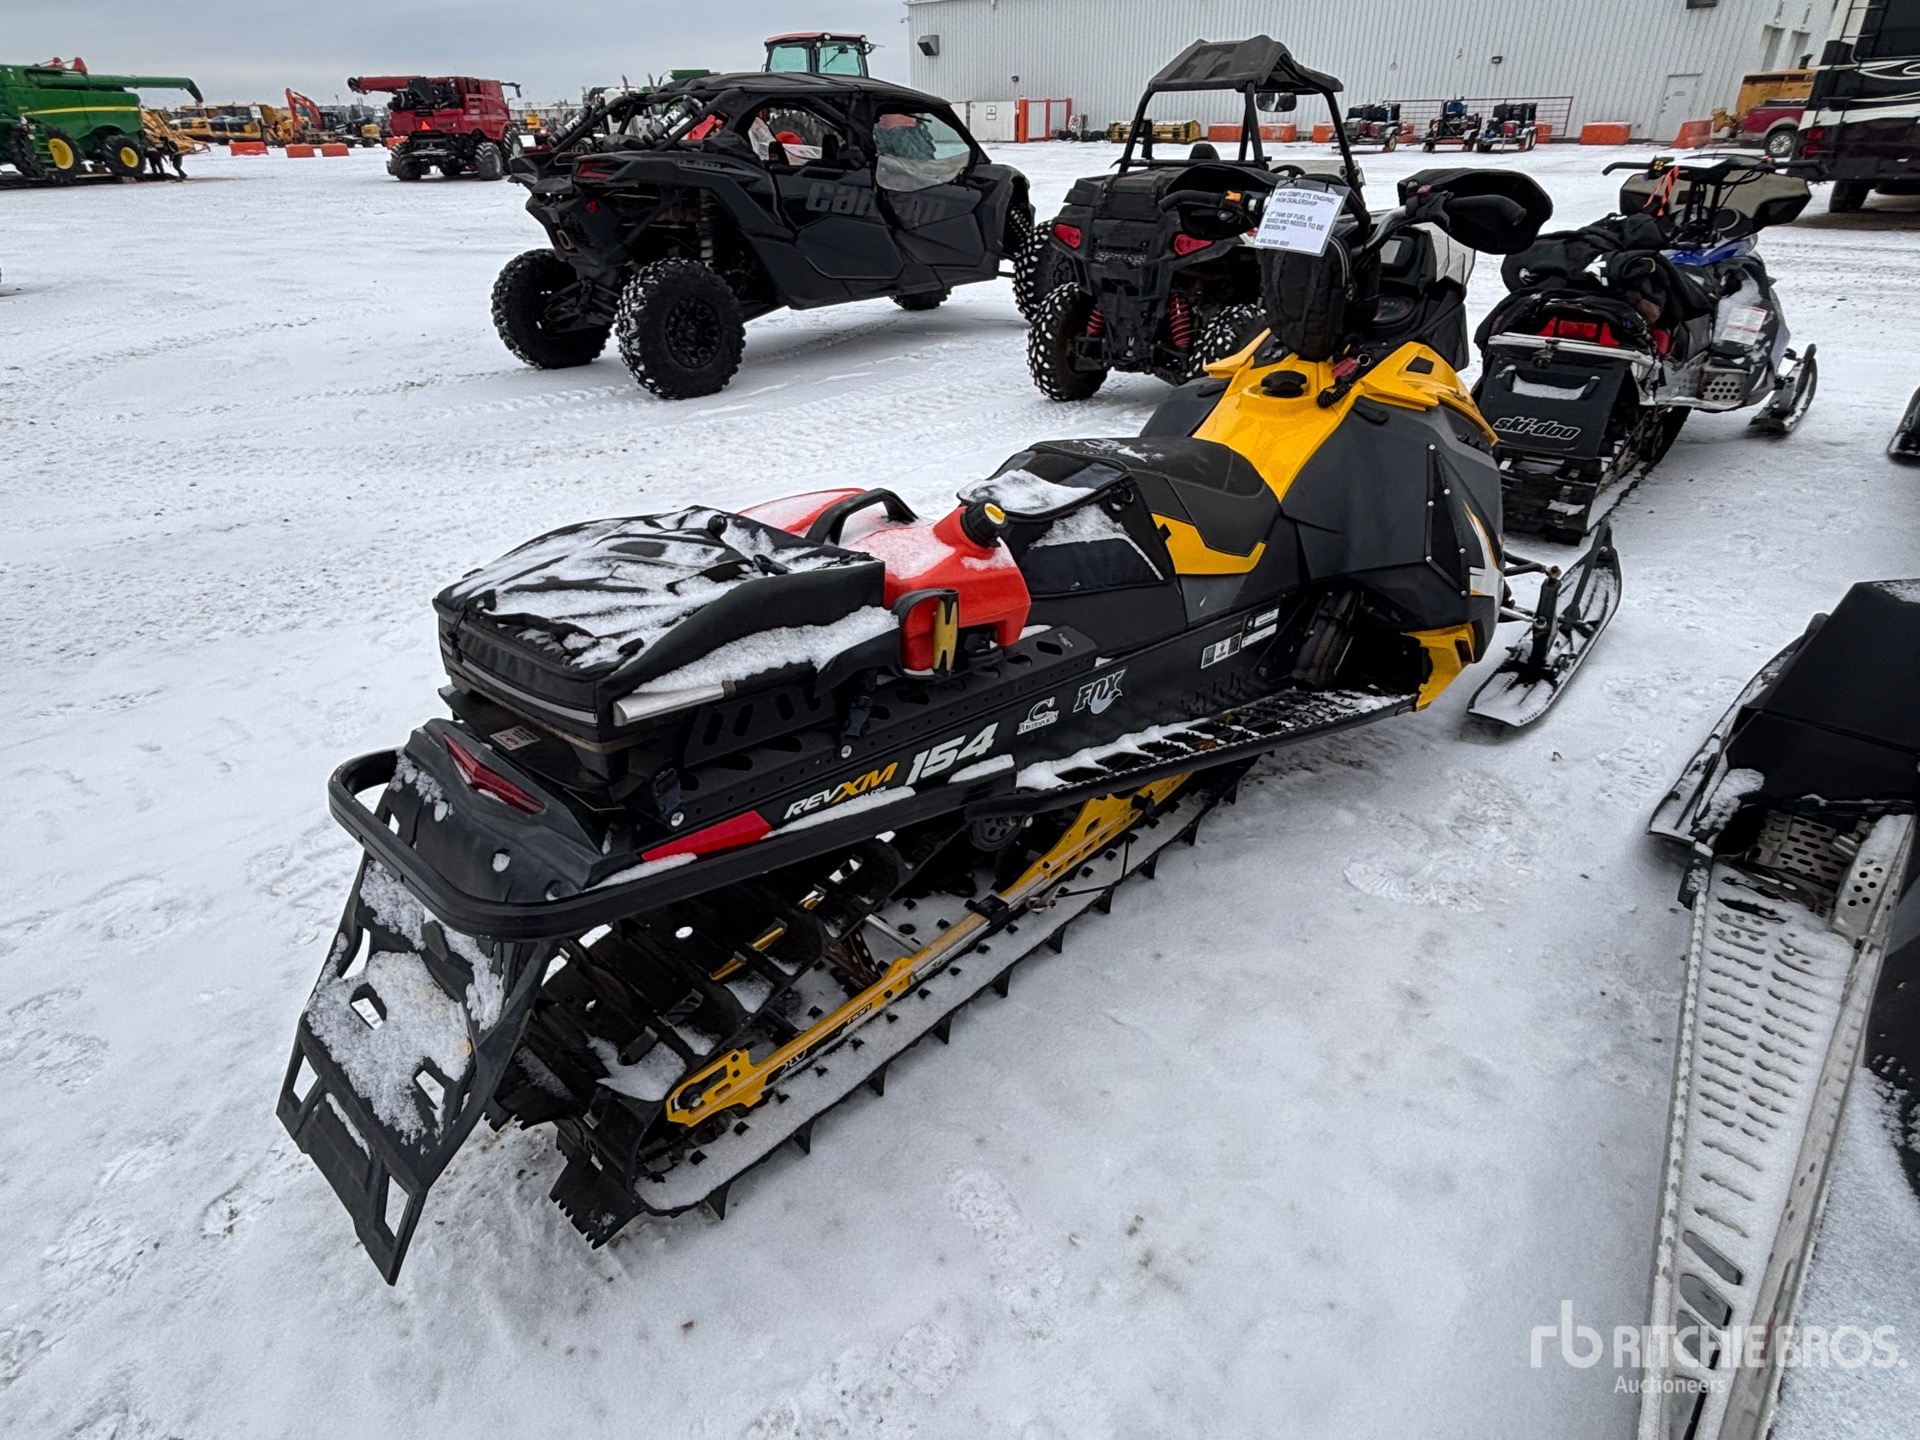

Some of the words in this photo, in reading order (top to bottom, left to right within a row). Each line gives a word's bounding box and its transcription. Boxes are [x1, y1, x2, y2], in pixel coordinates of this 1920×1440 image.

[1286, 198, 1318, 206] DEALERSHIP
[1290, 220, 1307, 228] NEEDS
[1294, 213, 1306, 221] FUEL
[1492, 416, 1581, 440] ski-doo
[1073, 668, 1126, 714] FOX
[904, 721, 999, 787] 154
